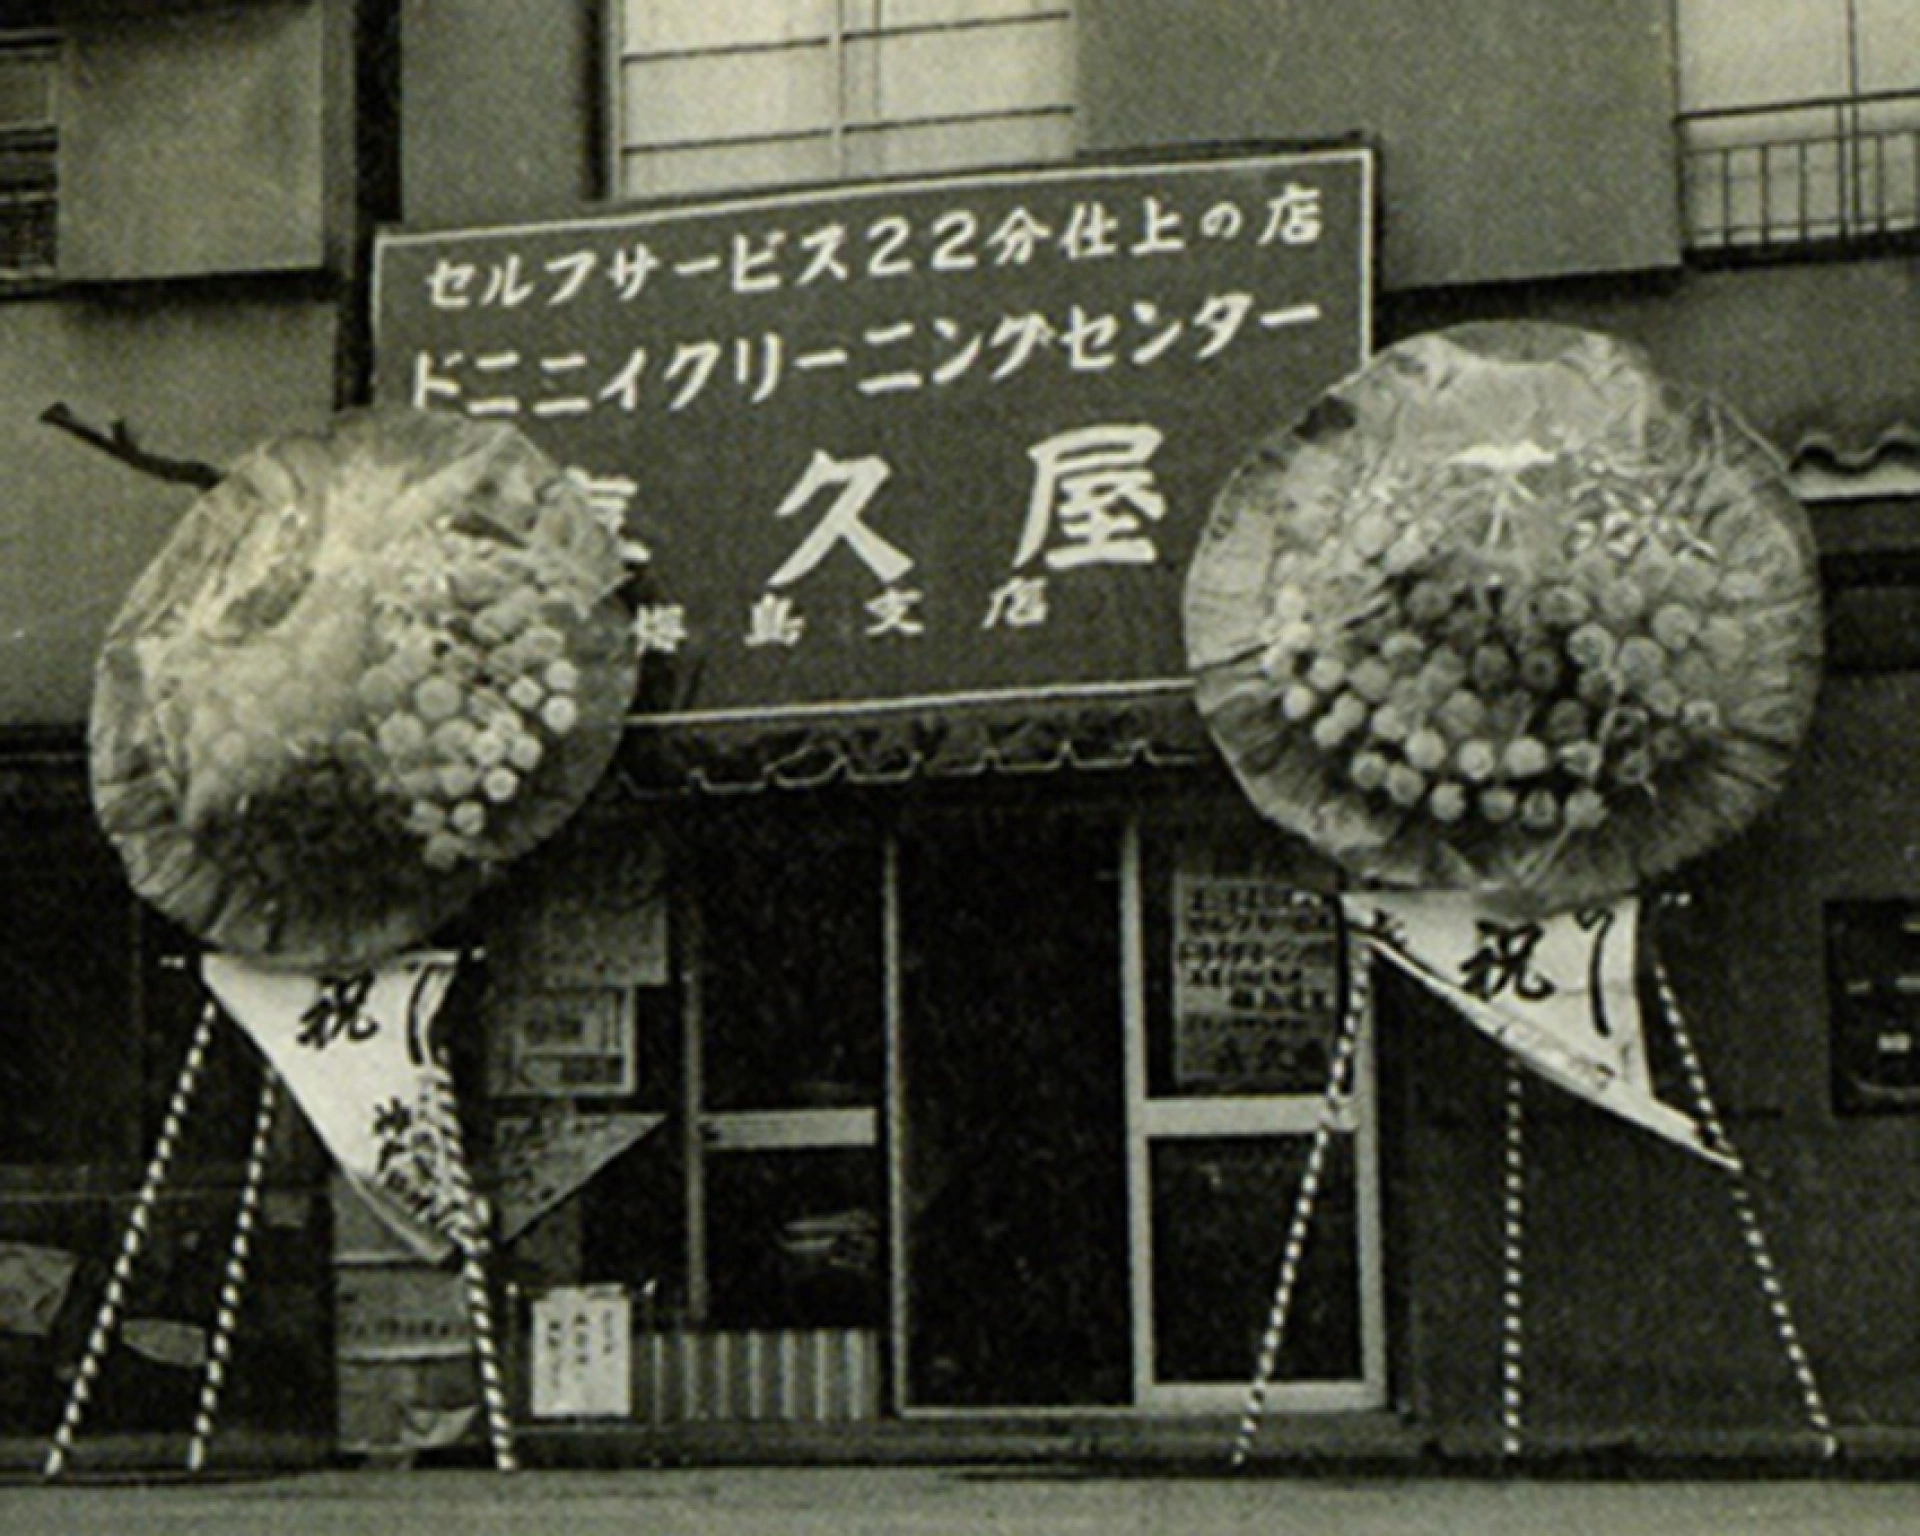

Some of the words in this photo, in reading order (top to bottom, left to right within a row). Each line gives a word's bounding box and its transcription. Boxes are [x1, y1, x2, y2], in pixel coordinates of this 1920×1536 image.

[426, 183, 1323, 309] セルフサービス22分仕上の店
[1460, 917, 1556, 1003] 祝
[296, 968, 380, 1050] 祝
